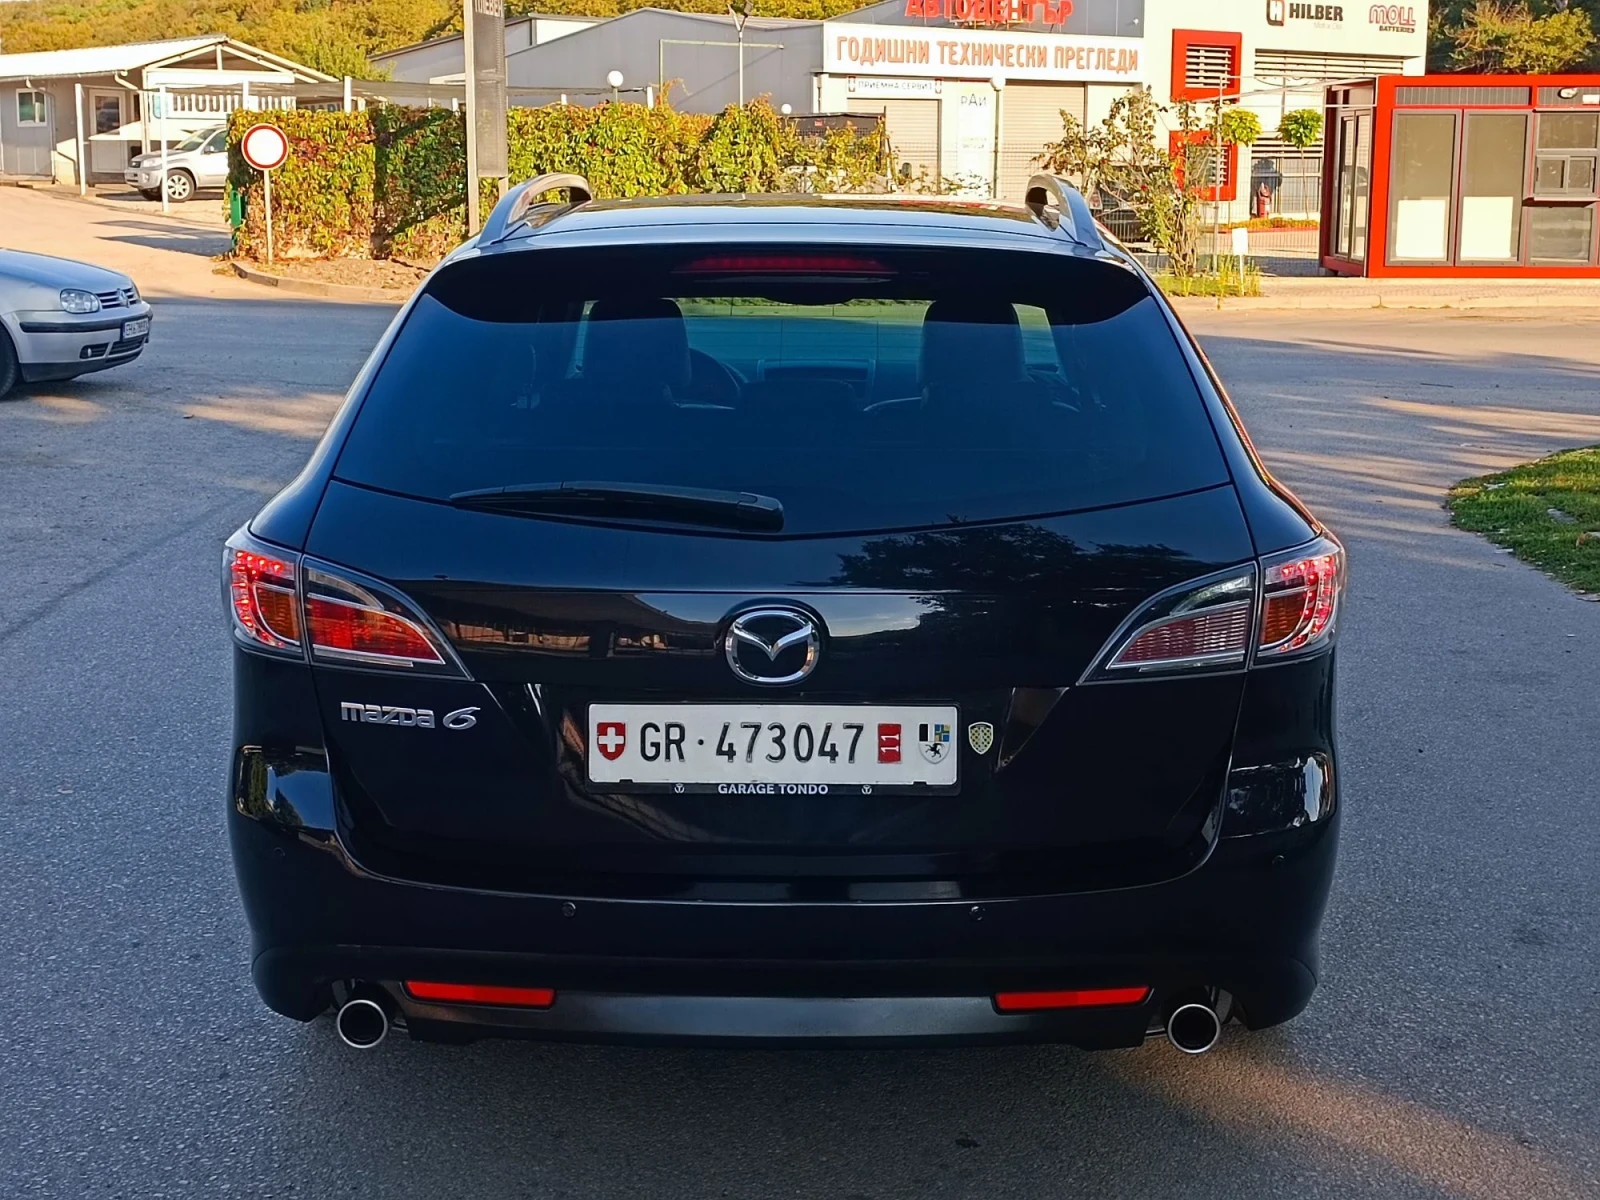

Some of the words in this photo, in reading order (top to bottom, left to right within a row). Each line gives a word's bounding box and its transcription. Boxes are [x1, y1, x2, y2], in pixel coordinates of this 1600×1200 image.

[1289, 3, 1343, 21] HILBER
[1369, 4, 1416, 25] MOLL
[1379, 25, 1415, 33] BATTERIES
[836, 36, 929, 65] ГОДИШНИ
[937, 40, 1047, 68] ТЕХНИЧЕСКИ
[1054, 46, 1138, 74] ПРЕГЛЕДИ
[443, 707, 480, 730] 6
[640, 722, 686, 763] GR
[715, 722, 864, 764] 473047
[718, 784, 774, 794] GARAGE
[779, 784, 829, 795] TONDO
